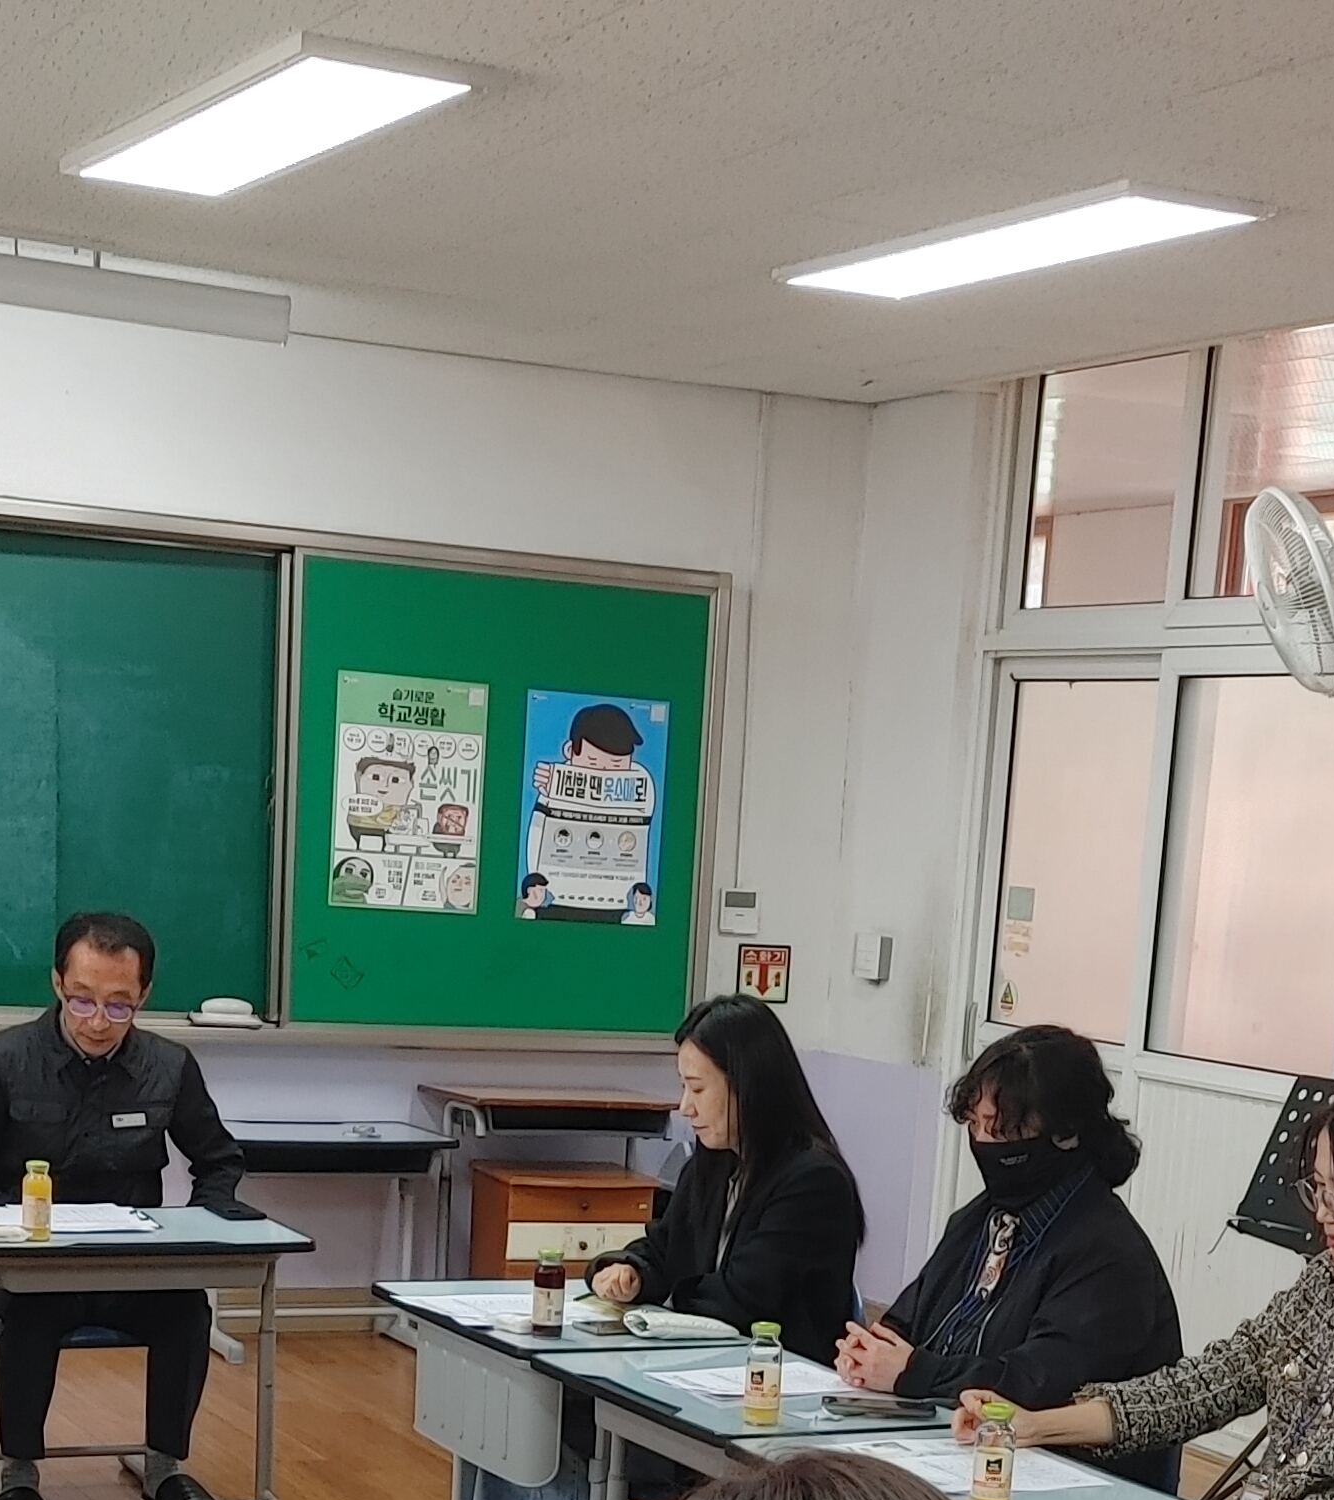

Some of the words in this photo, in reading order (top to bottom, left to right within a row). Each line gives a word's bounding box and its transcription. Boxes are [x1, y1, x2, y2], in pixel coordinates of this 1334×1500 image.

[392, 688, 435, 704] 슬기로운
[378, 702, 446, 727] 학교생활
[418, 765, 478, 805] 손씻기
[556, 769, 587, 799] 기침할
[589, 775, 603, 801] 땐
[744, 950, 785, 963] 소화기
